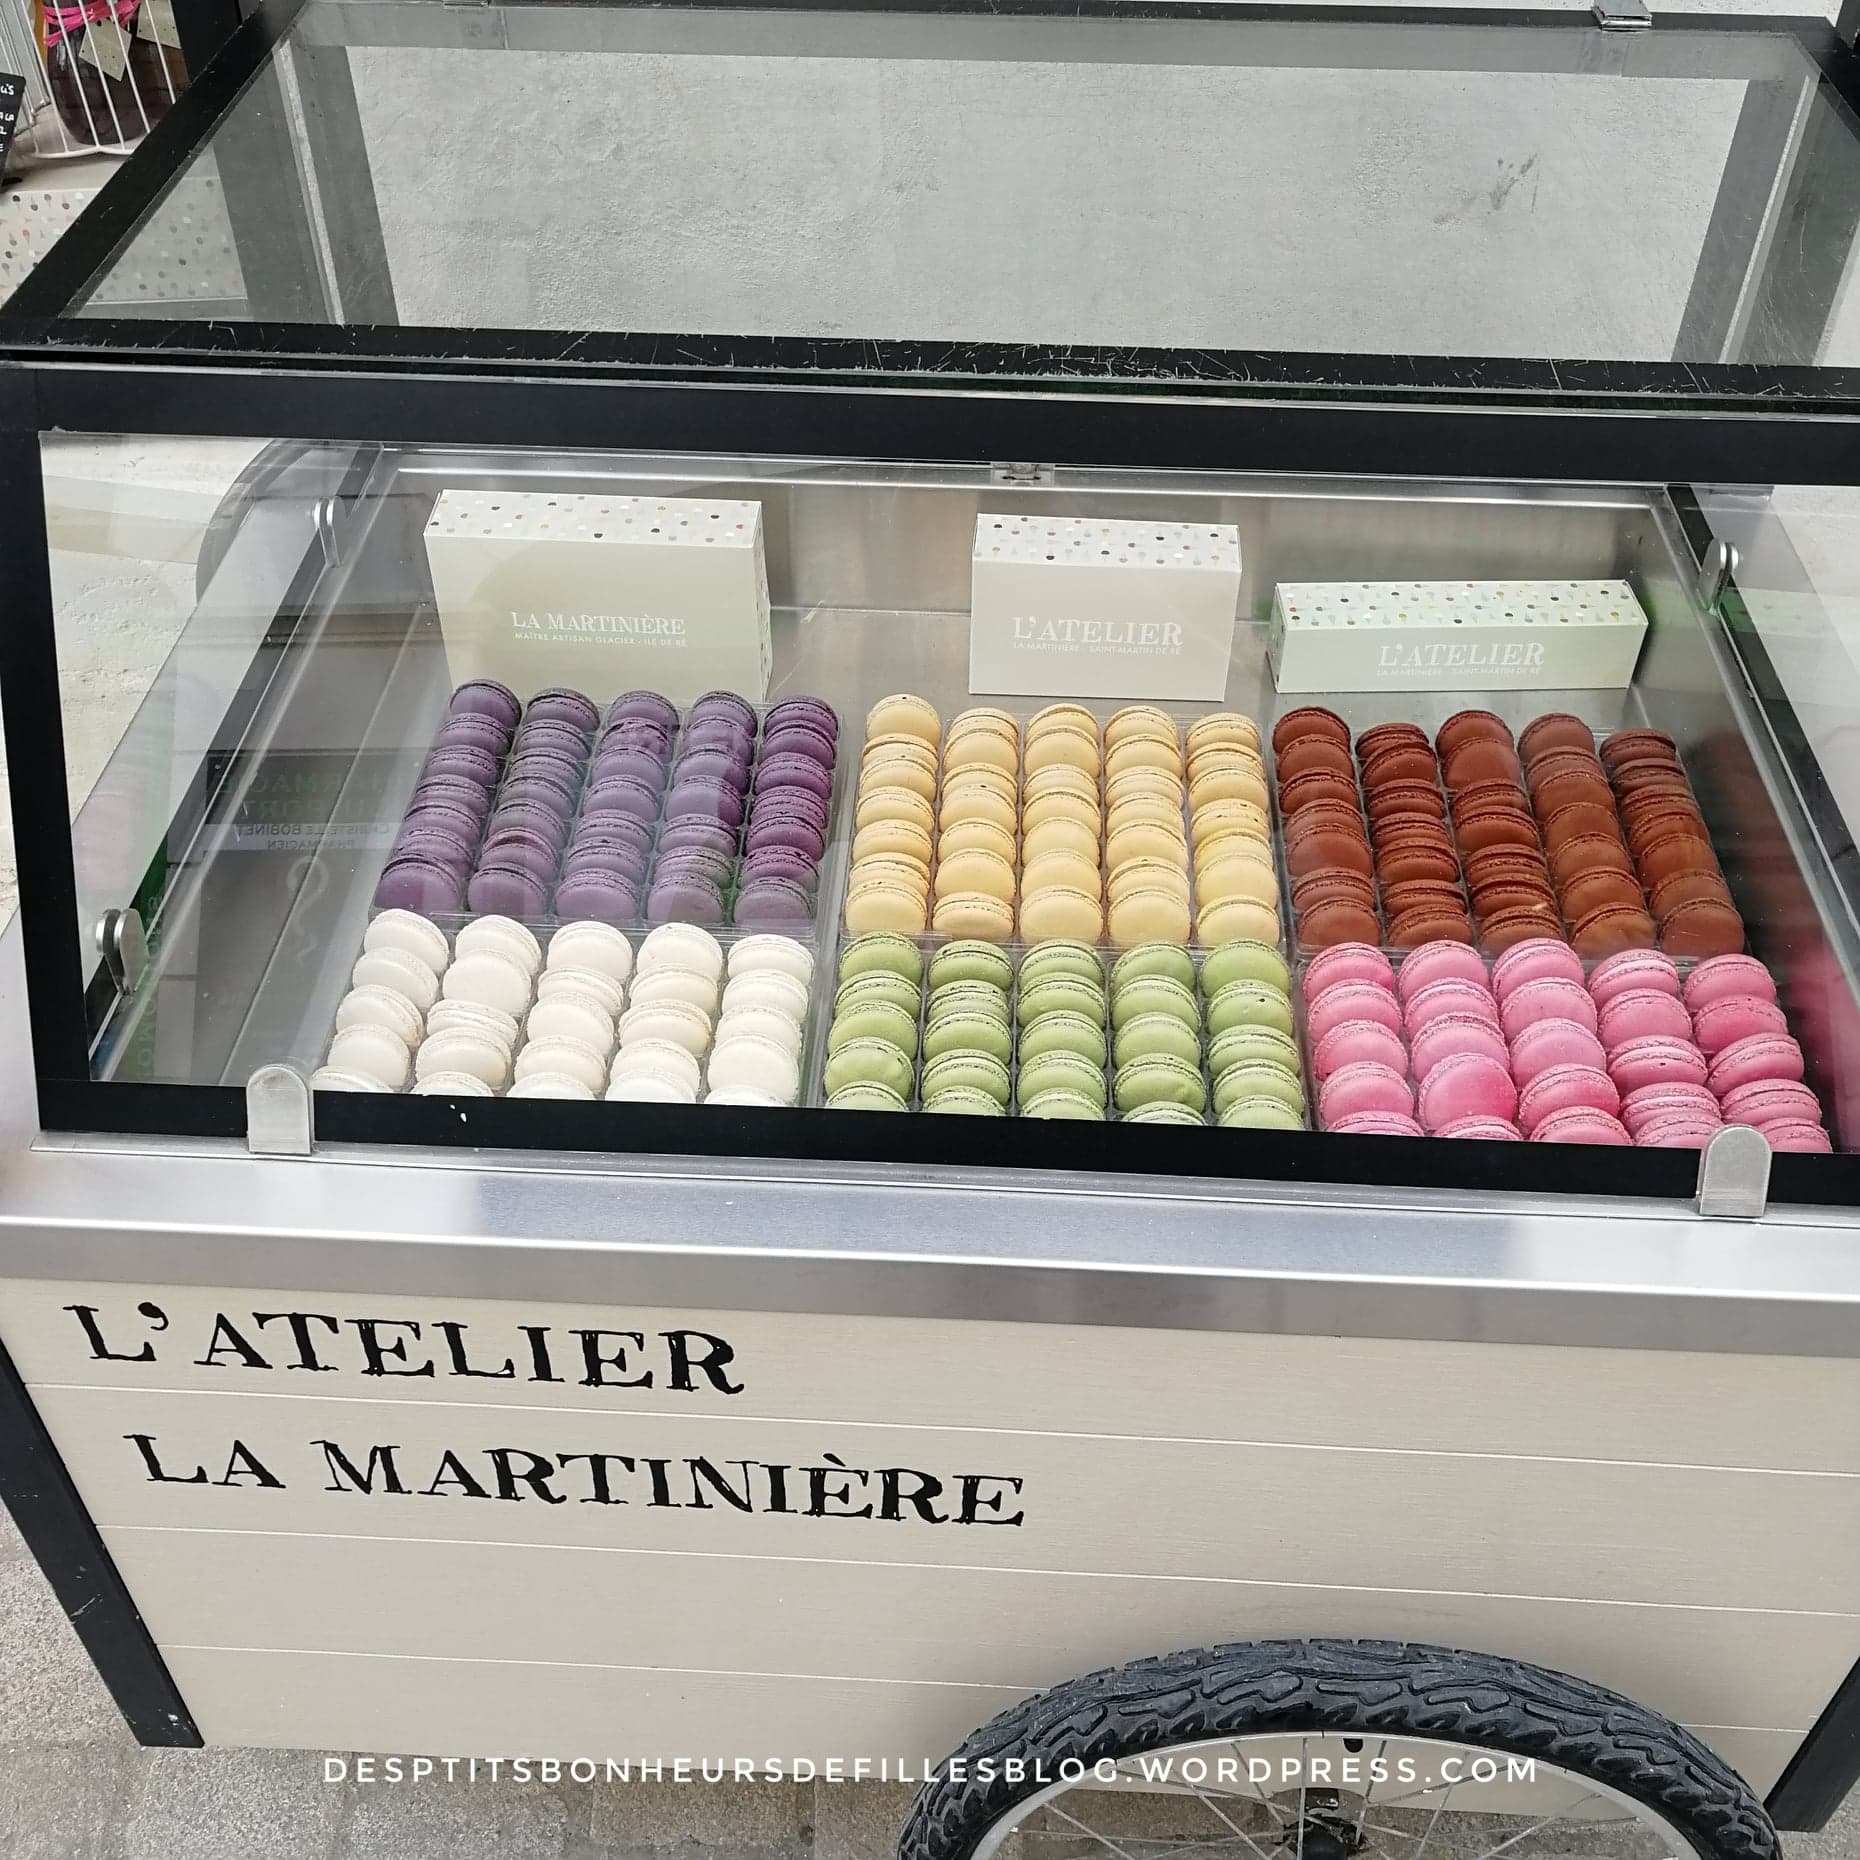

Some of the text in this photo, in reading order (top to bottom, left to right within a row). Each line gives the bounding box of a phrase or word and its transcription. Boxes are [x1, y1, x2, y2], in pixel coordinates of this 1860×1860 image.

[510, 611, 686, 635] LA MARTINIÈRE
[1012, 616, 1183, 646] L'ATELIER
[552, 633, 593, 643] ARTISAN
[660, 638, 672, 648] DE
[1013, 641, 1025, 650] LA
[1155, 646, 1168, 656] DE
[1378, 642, 1545, 666] L'ATELIER
[63, 1302, 745, 1395] L'ATELIER
[122, 1434, 1024, 1527] LA MARTINIÈRE
